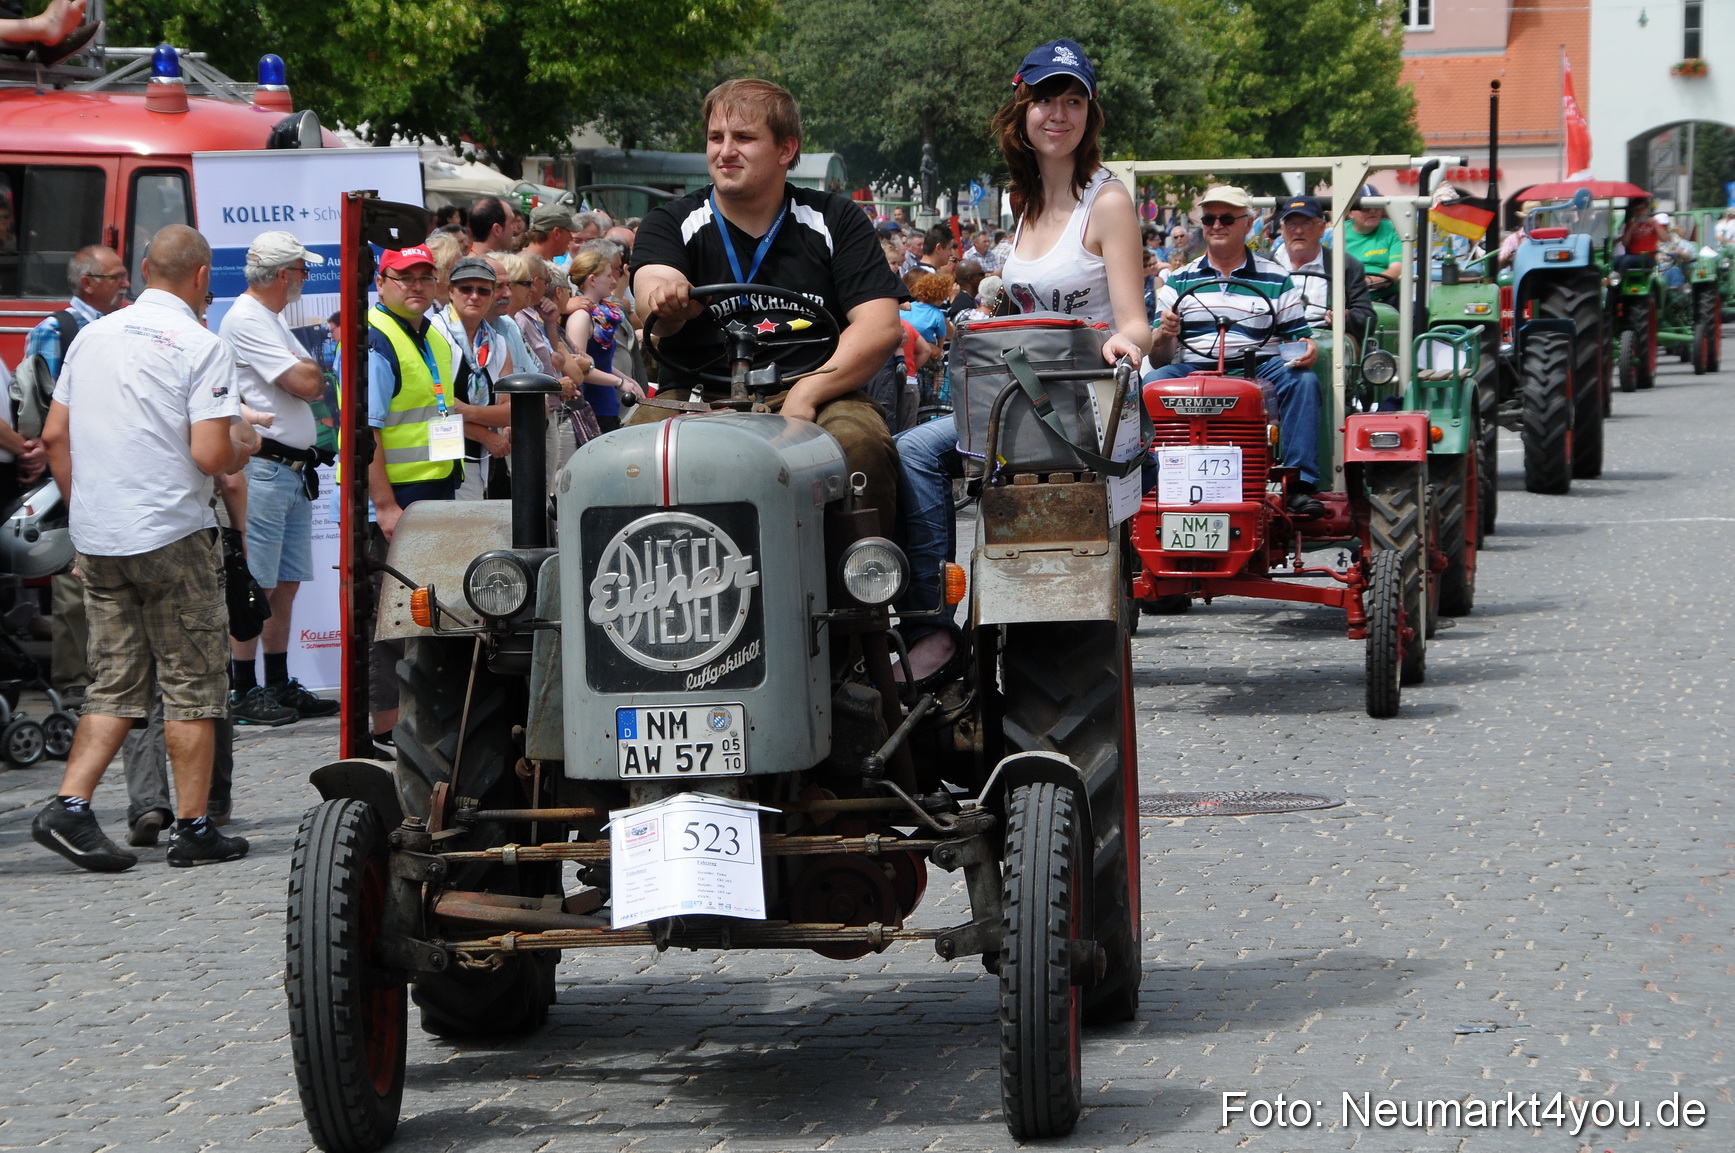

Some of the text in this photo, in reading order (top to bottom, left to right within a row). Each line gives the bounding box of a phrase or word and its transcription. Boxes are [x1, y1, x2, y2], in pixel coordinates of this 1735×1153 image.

[222, 204, 296, 224] KOLLER
[401, 248, 427, 257] DEKRA
[1167, 398, 1231, 408] FARMALL
[1197, 458, 1232, 477] 473
[1182, 516, 1209, 533] NM
[1170, 533, 1220, 549] AD 17
[588, 554, 760, 626] Eicher
[685, 639, 761, 692] luftgekühlt
[624, 727, 632, 738] D
[646, 709, 689, 740] NM
[721, 738, 741, 751] 05
[624, 742, 714, 774] AW 57
[723, 756, 742, 770] 10
[682, 820, 741, 856] 523
